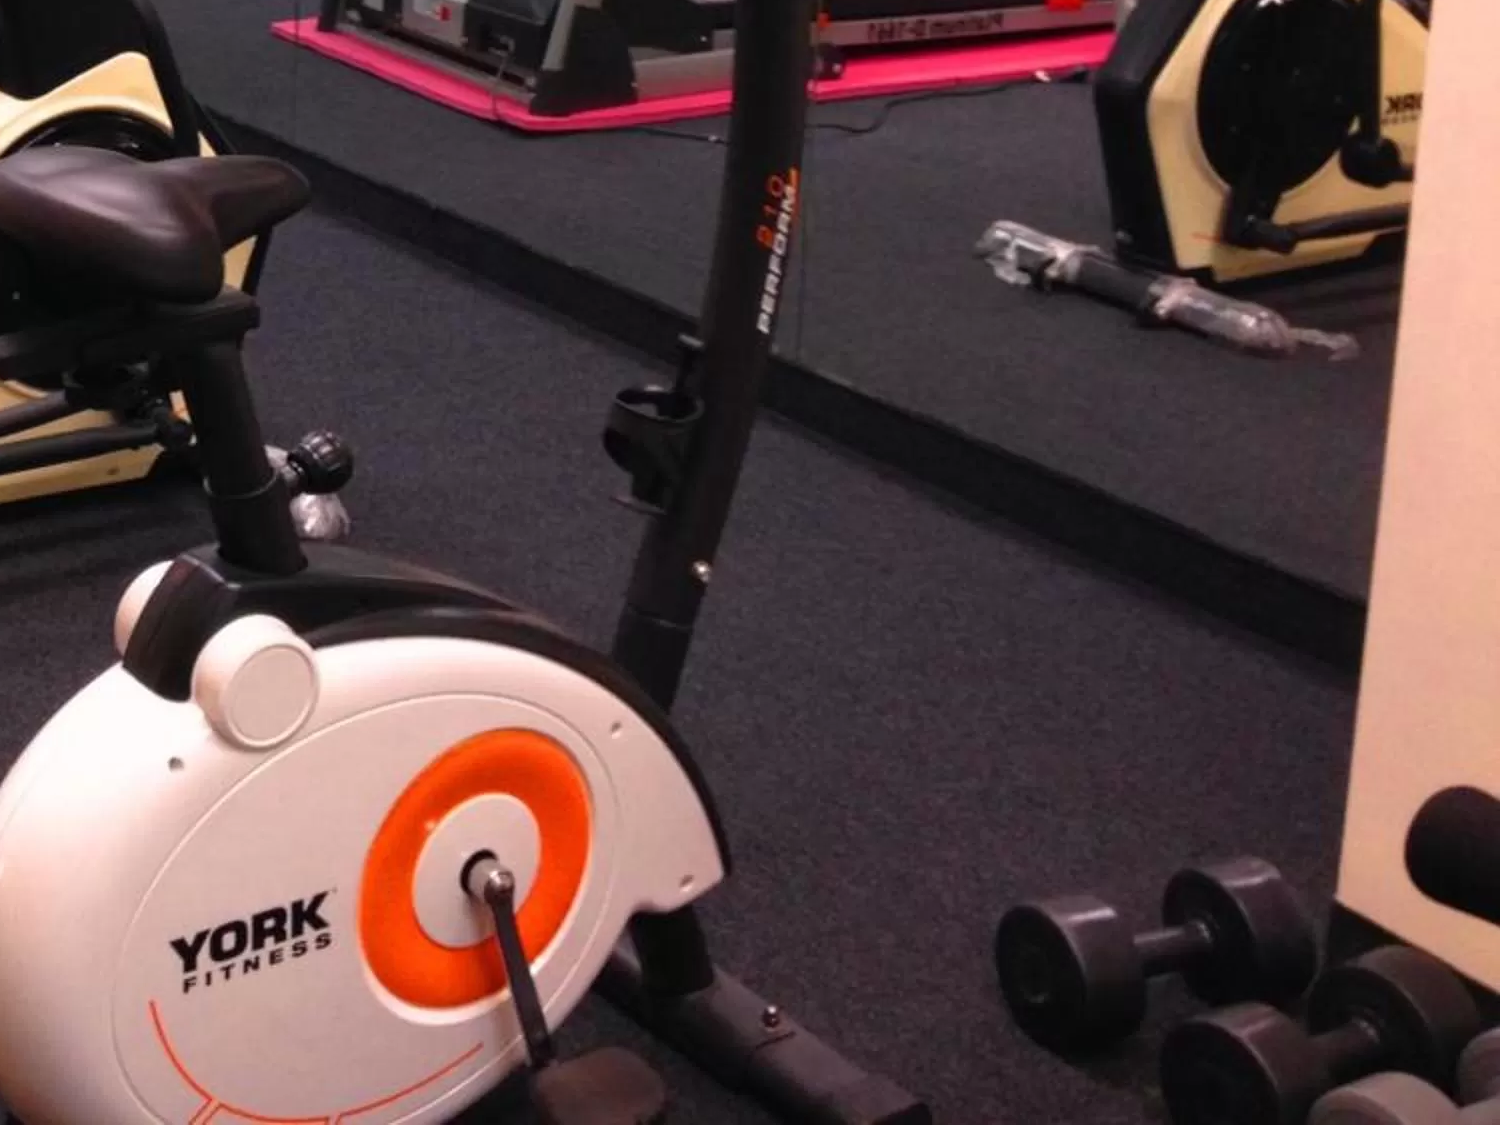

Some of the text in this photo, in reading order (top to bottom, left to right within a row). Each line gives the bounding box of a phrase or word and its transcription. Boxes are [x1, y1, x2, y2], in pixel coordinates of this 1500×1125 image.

[757, 185, 795, 335] PERFORM
[169, 890, 331, 974] YORK
[182, 931, 333, 994] FITNESS
